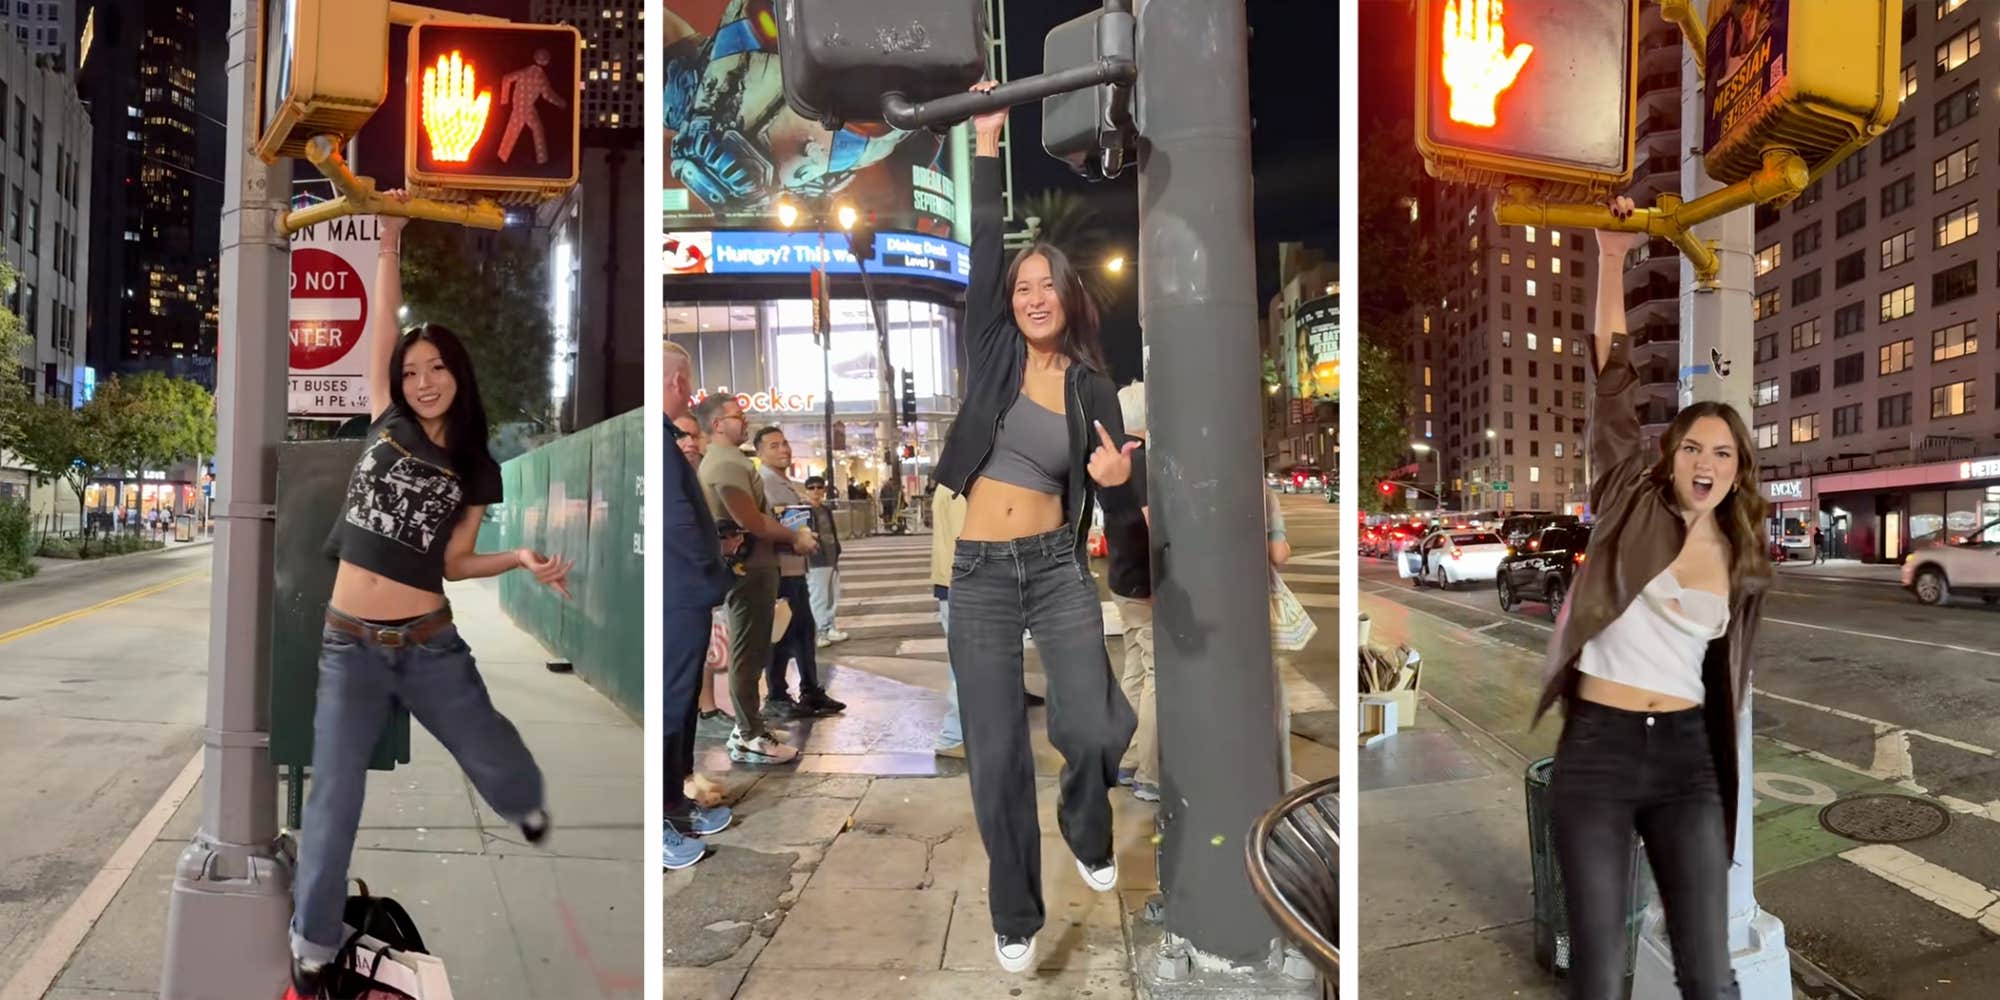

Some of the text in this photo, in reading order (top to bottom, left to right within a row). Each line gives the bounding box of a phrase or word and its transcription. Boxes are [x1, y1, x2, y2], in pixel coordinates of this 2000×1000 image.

[1711, 35, 1772, 120] MESSIAH
[328, 218, 381, 241] MALL
[717, 244, 790, 266] Hungry?
[793, 245, 830, 262] This
[904, 254, 928, 268] Level
[305, 271, 349, 291] NOT
[304, 380, 348, 392] BUSES
[718, 386, 816, 413] ocker
